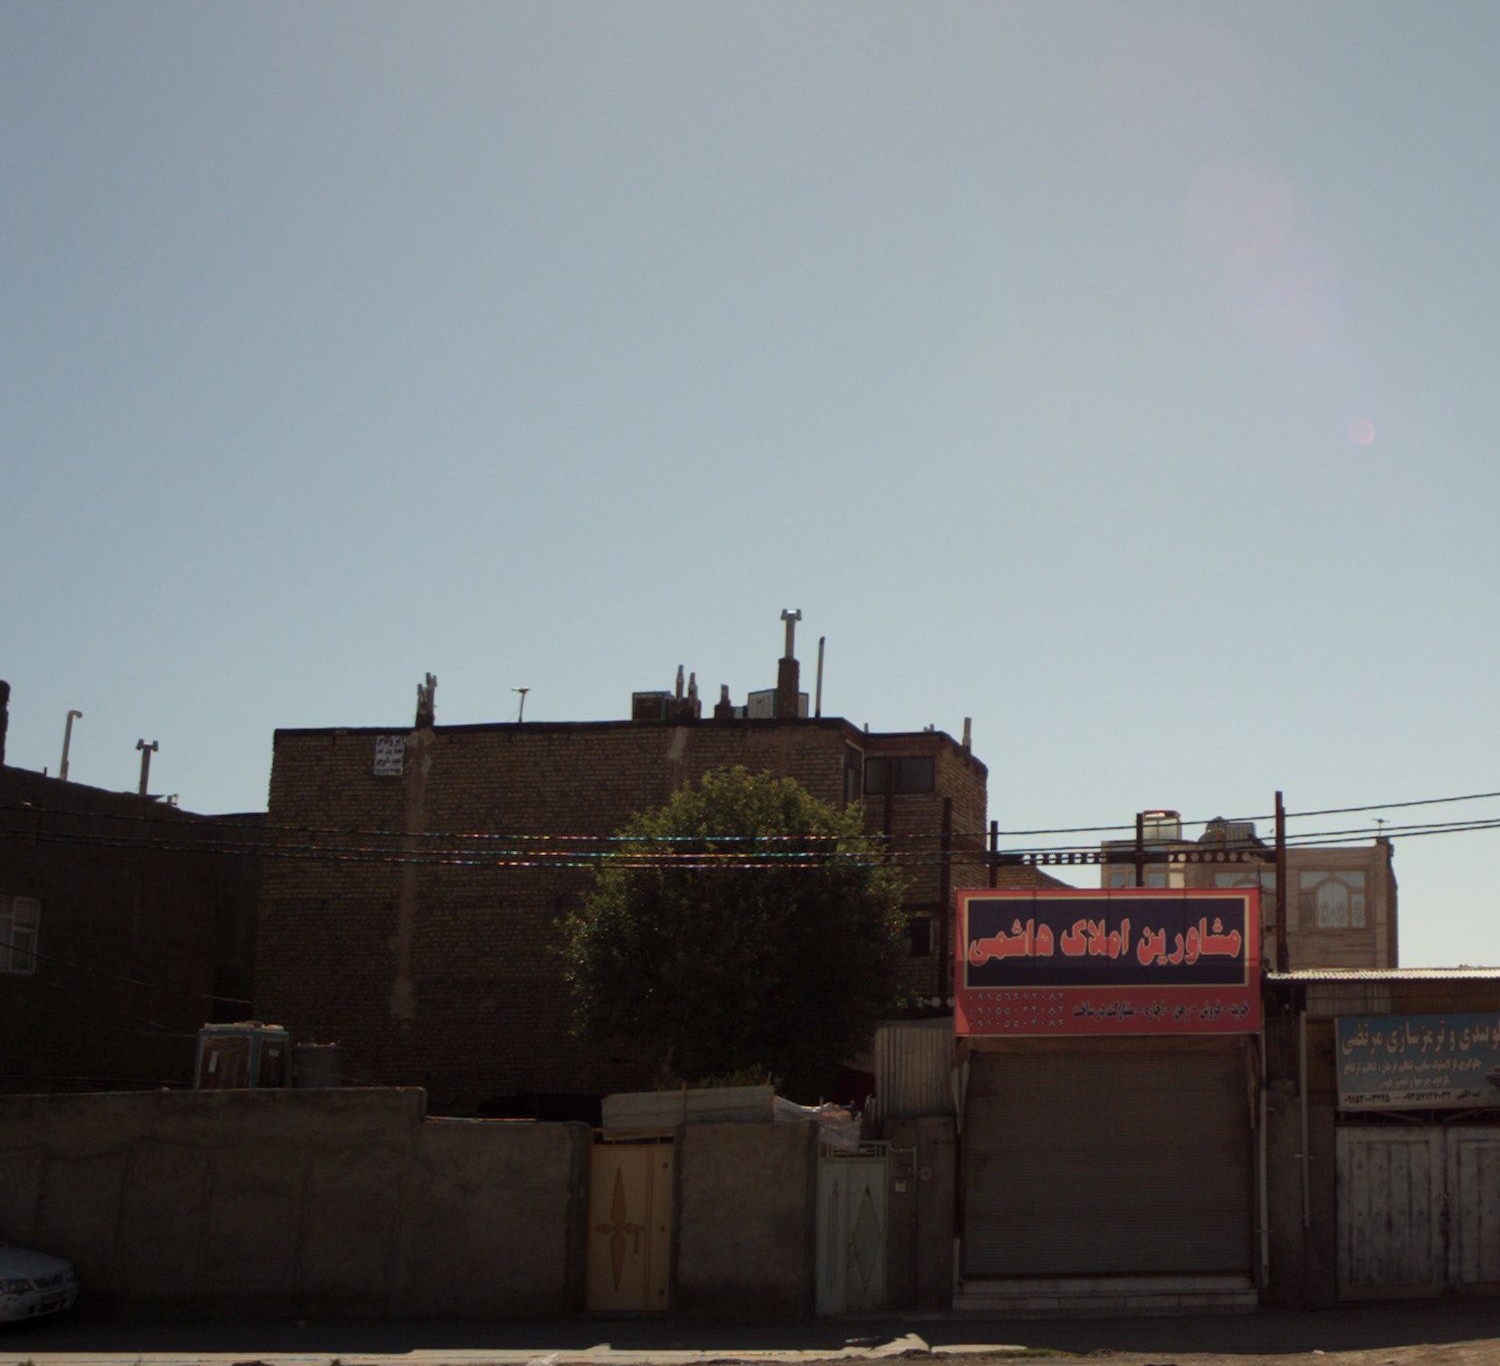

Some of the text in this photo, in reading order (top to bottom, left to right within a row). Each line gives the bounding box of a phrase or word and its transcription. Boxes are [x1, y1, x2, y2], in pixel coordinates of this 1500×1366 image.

[968, 916, 1243, 967] مشاورین املاک هاشمی
[1341, 1022, 1383, 1055] مرتضی
[1448, 1028, 1456, 1051] و
